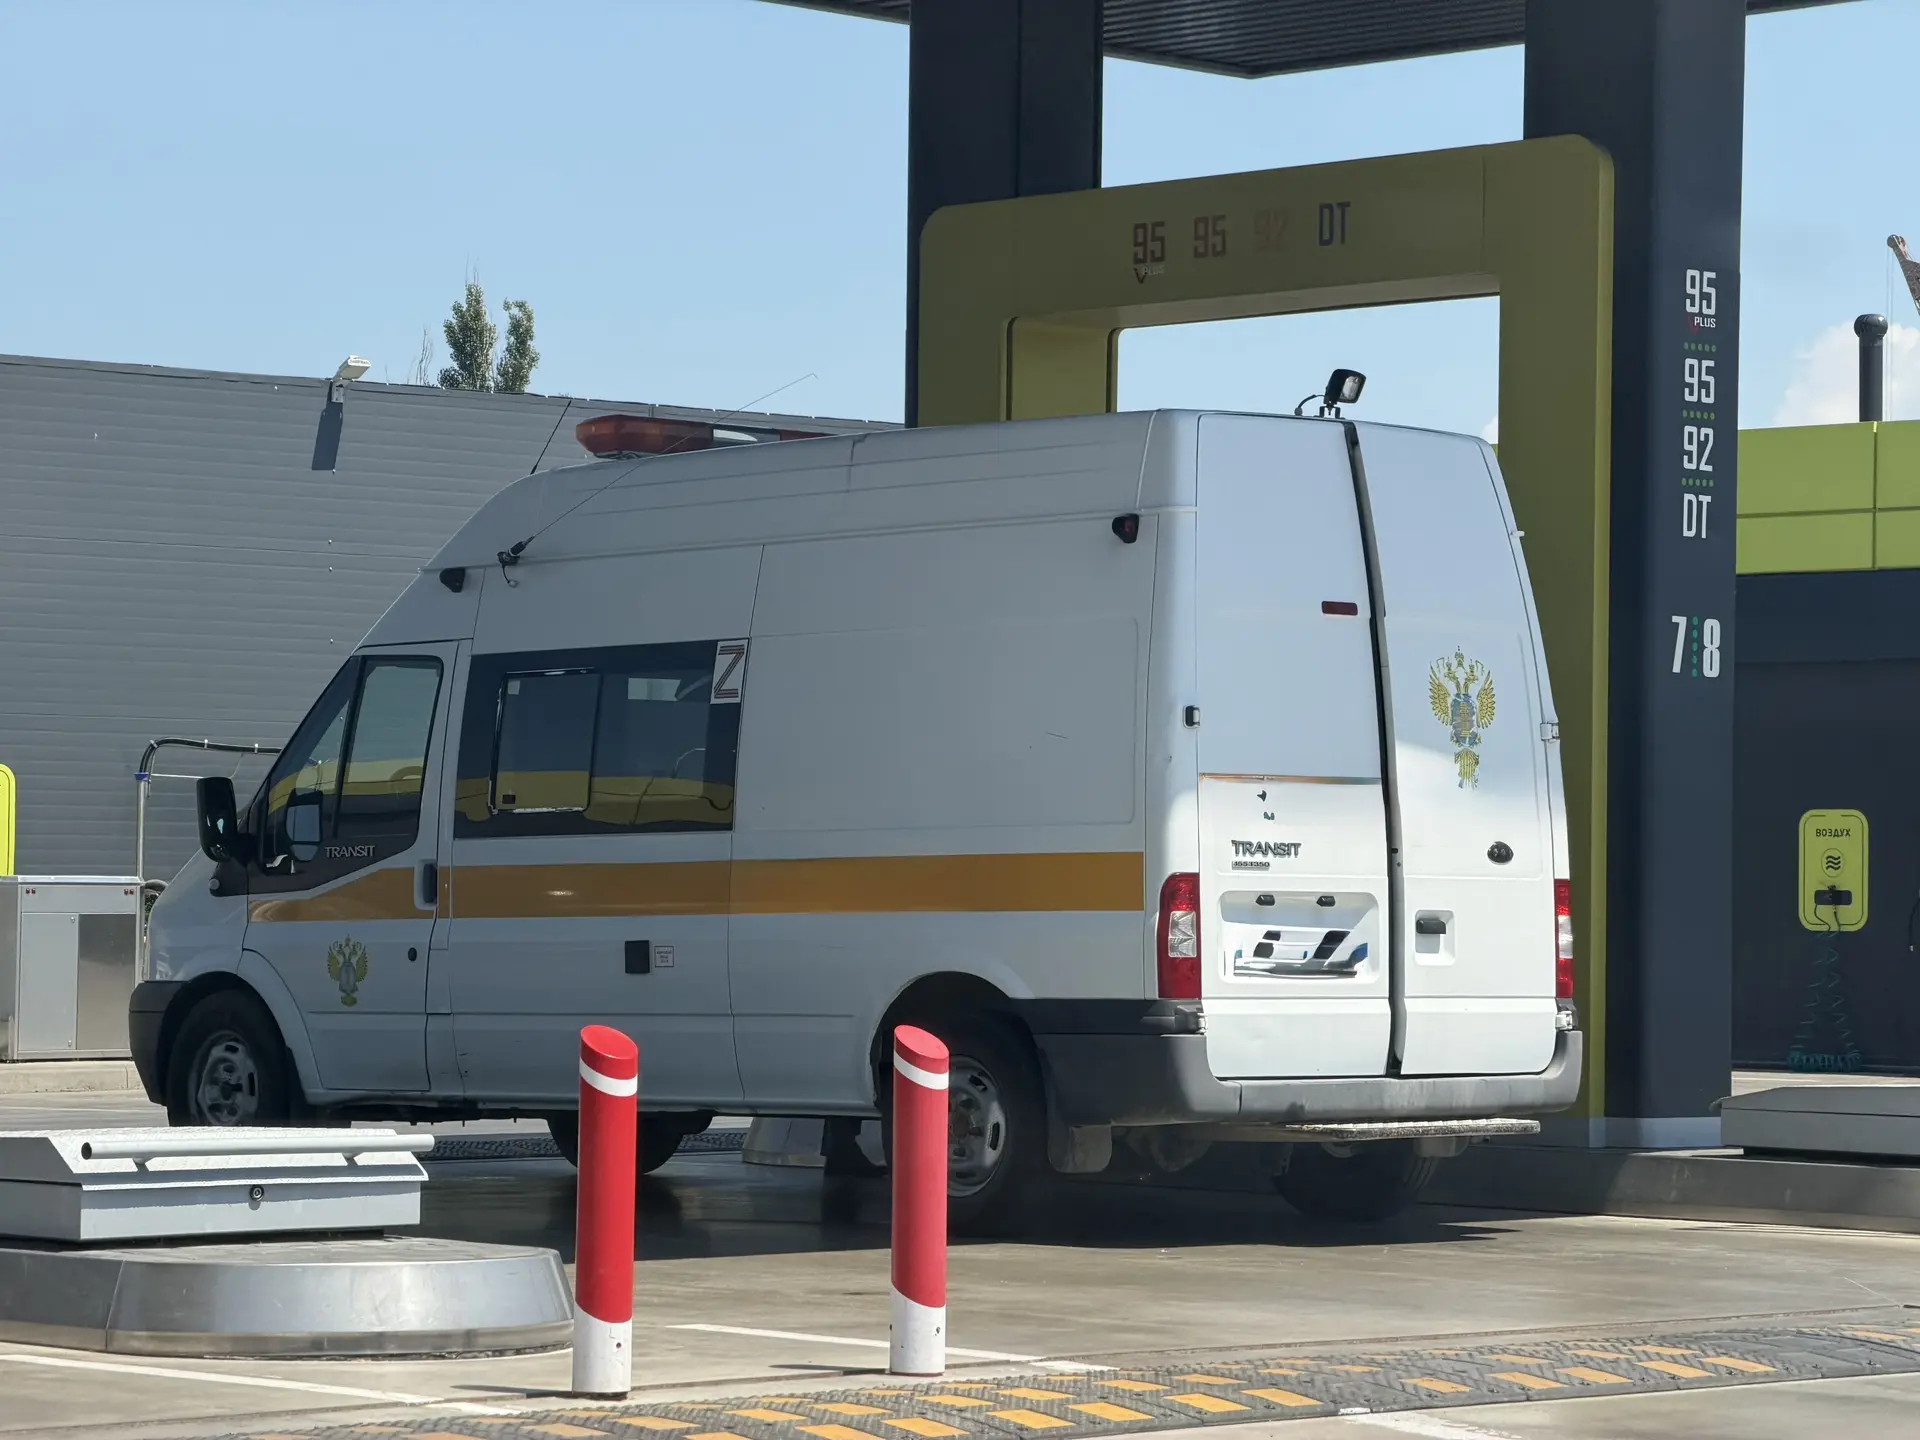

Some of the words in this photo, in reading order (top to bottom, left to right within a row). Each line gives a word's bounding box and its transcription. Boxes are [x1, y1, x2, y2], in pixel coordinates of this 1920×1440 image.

[1133, 220, 1165, 264] 95
[1193, 215, 1226, 258] 95
[1318, 201, 1350, 246] DT
[1685, 268, 1717, 315] 95
[1694, 316, 1716, 328] PLUS
[1684, 358, 1715, 404] 95
[1683, 425, 1714, 471] 92
[1682, 493, 1712, 539] DT
[1671, 615, 1687, 673] 7
[1703, 618, 1721, 678] 8
[713, 644, 745, 699] Z
[324, 845, 376, 858] TRANSIT
[1231, 840, 1302, 858] TRANSIT
[1815, 828, 1851, 837] ВОЗДУХ
